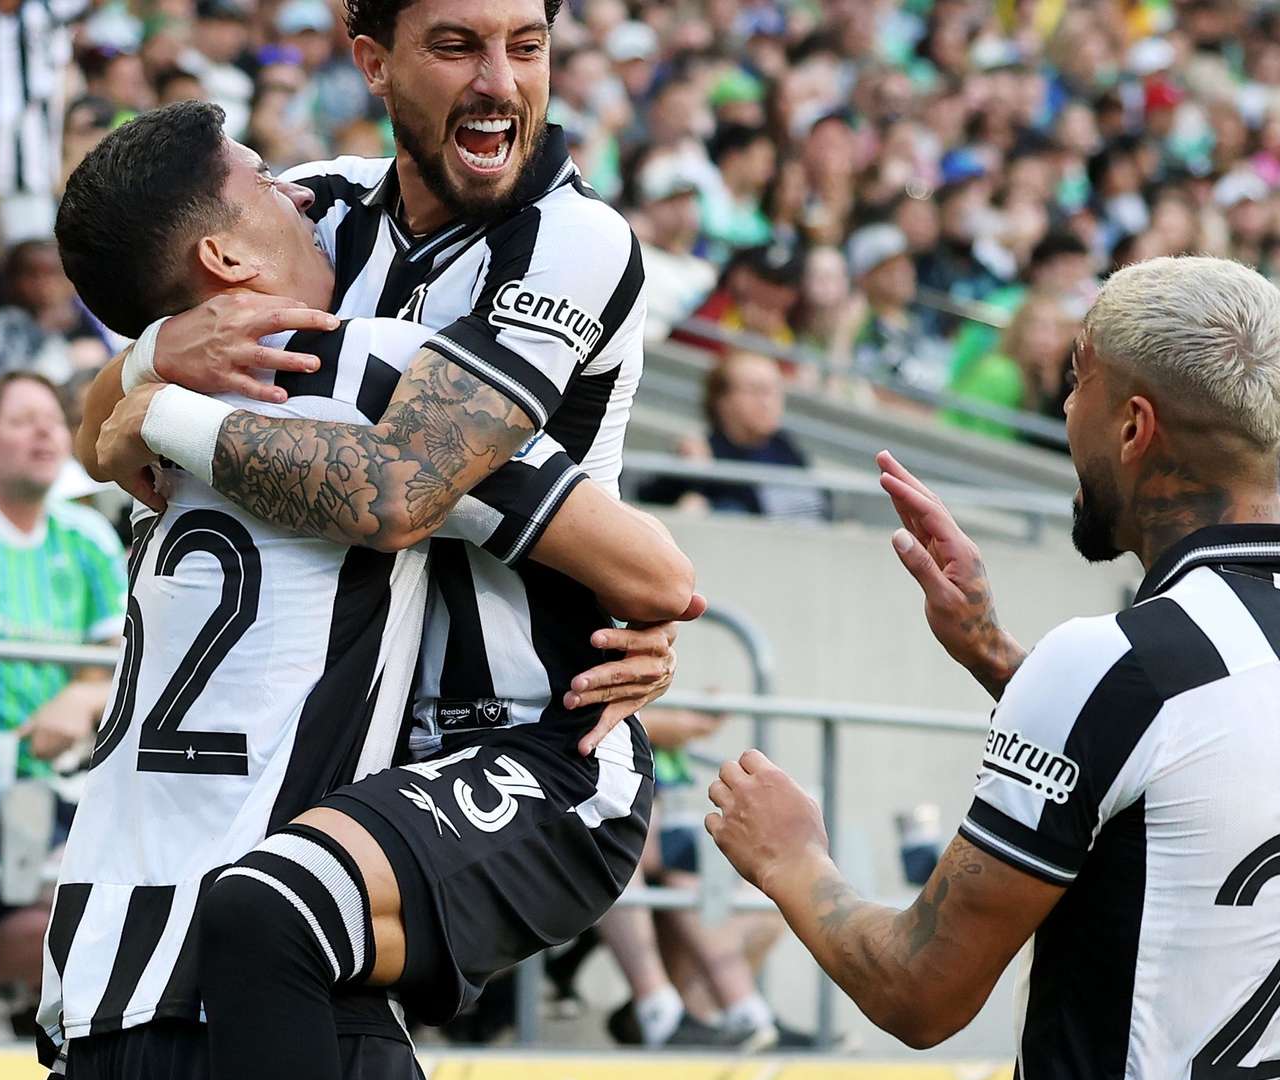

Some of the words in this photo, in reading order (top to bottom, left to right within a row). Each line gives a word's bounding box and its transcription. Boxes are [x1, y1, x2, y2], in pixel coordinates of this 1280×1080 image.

[496, 283, 601, 348] Centrum
[440, 708, 471, 716] Reebok
[985, 729, 1076, 787] entrum
